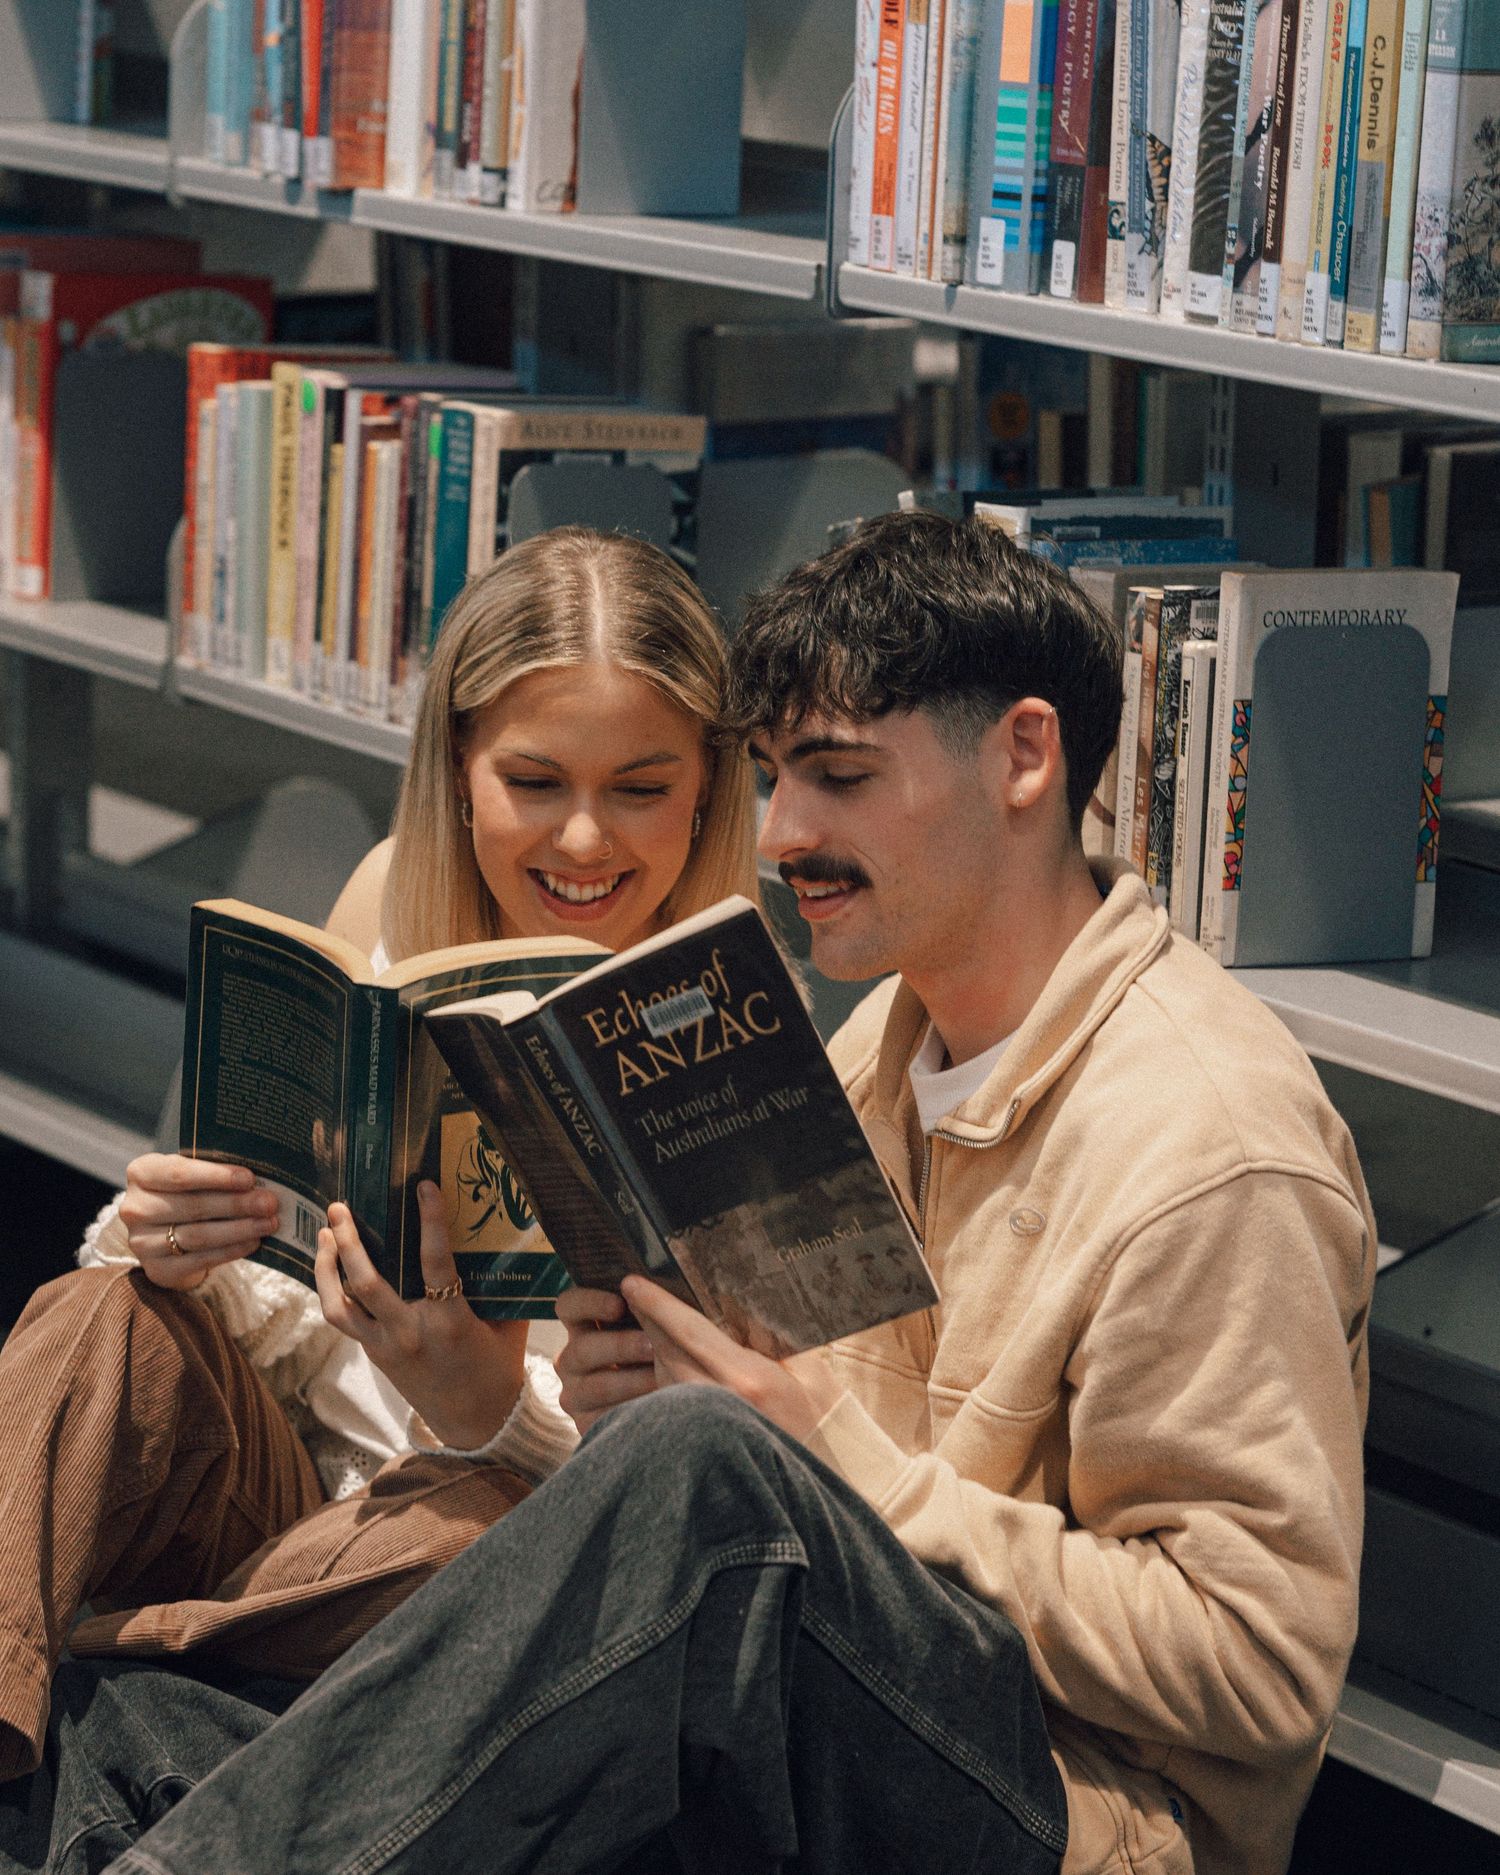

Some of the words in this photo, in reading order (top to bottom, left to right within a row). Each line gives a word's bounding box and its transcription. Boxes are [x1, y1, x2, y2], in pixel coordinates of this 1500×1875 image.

[1119, 13, 1129, 92] Australian
[1281, 15, 1291, 49] Three
[1331, 2, 1343, 62] GREAT
[879, 39, 897, 136] OUTRAGES
[1277, 53, 1288, 83] Faces
[1117, 99, 1127, 136] Love
[1261, 95, 1272, 128] War
[1115, 142, 1125, 192] Poems
[1254, 133, 1268, 190] Poetry
[1270, 146, 1280, 190] Ronald
[1323, 124, 1333, 169] BOOK
[1334, 221, 1347, 283] Chaucer
[1263, 608, 1408, 628] CONTEMPORARY
[1180, 679, 1192, 720] Kenneth
[1179, 722, 1190, 757] Slessor
[1136, 776, 1147, 805] Les
[1176, 779, 1186, 831] SELECTED
[1174, 833, 1184, 868] POEMS
[700, 948, 731, 1004] of
[616, 991, 782, 1097] ANZAC
[368, 1065, 378, 1090] MAD
[524, 1035, 558, 1084] Echoes
[547, 1077, 569, 1099] of
[559, 1092, 602, 1158] ANZAC
[635, 1108, 676, 1138] The
[677, 1090, 718, 1121] voice
[720, 1073, 741, 1106] of
[654, 1111, 751, 1164] Australians
[752, 1100, 770, 1123] at
[769, 1086, 810, 1113] War
[777, 1236, 833, 1262] Graham
[832, 1217, 864, 1240] Seal
[470, 1269, 495, 1282] Livio
[497, 1270, 532, 1282] Dobrez
